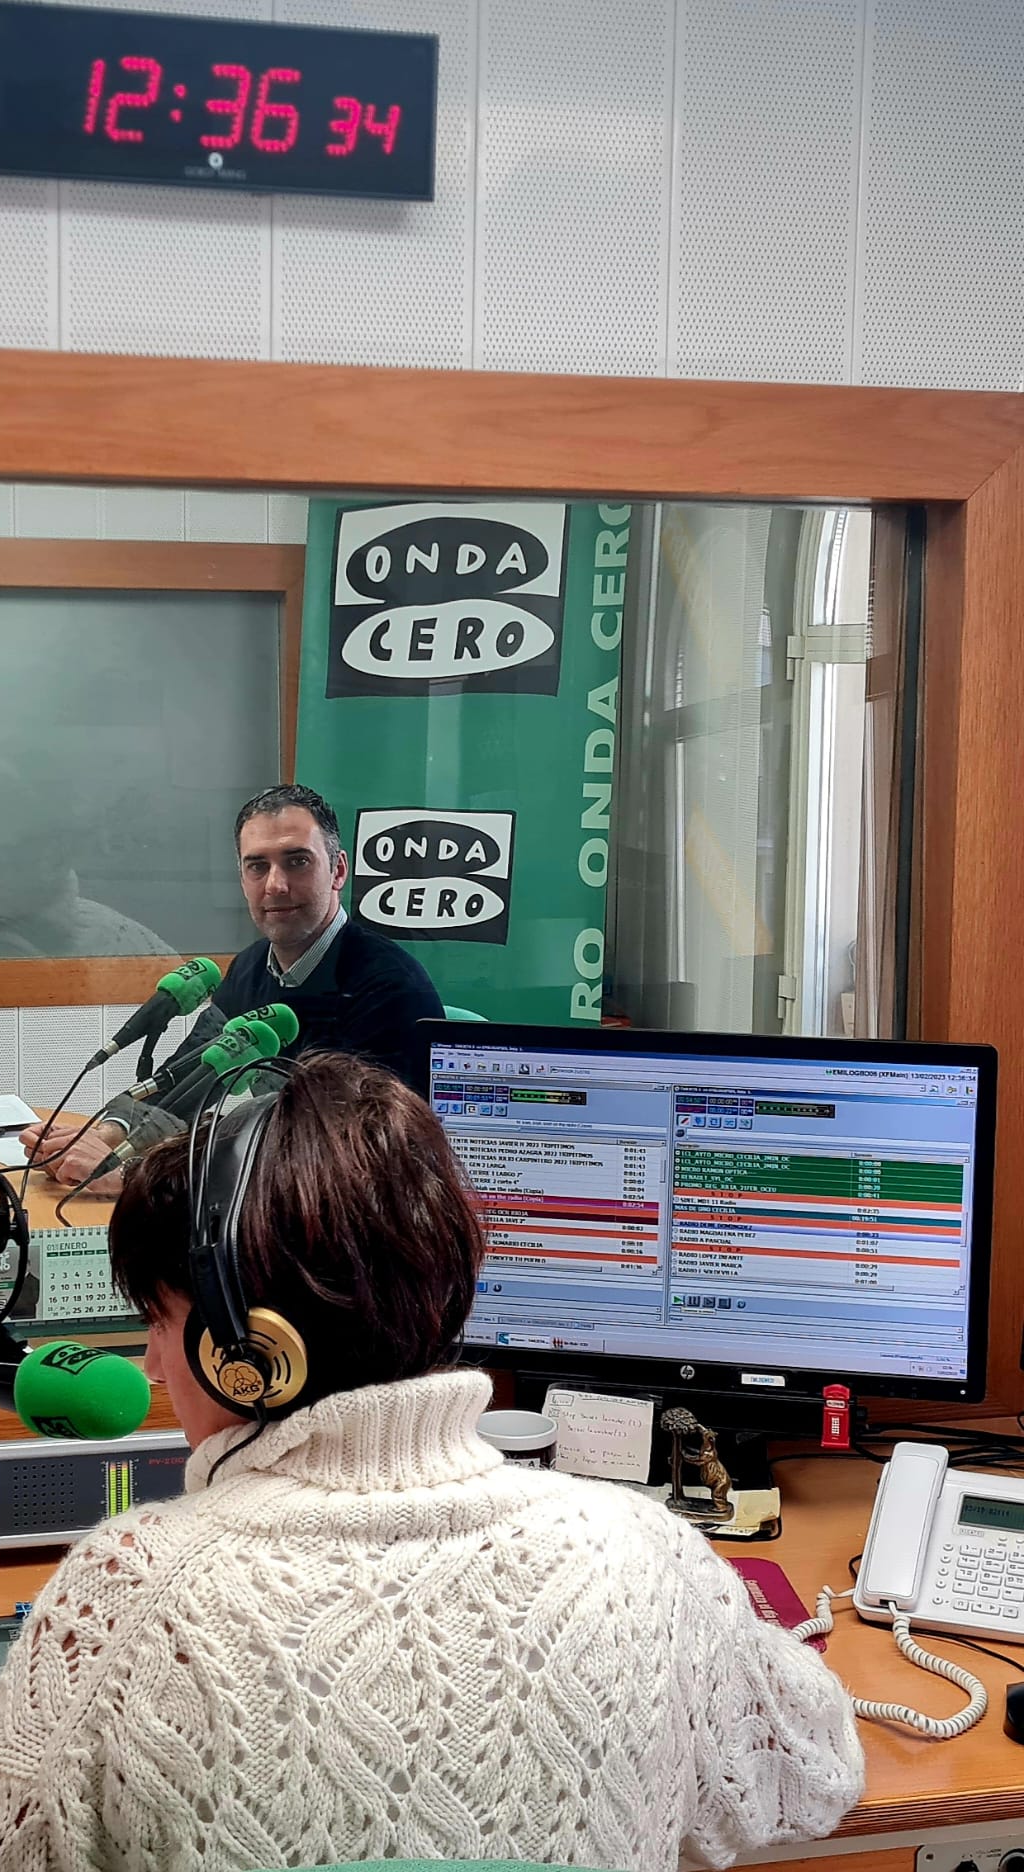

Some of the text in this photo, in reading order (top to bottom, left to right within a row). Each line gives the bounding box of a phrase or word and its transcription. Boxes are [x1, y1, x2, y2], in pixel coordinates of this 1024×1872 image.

[83, 56, 401, 157] 12:36 34
[365, 542, 527, 583] ONDA
[369, 617, 525, 662] CERO
[578, 675, 619, 888] ONDA
[375, 836, 487, 863] ONDA
[378, 886, 484, 918] CERO
[59, 1241, 88, 1250] ENERO
[96, 1293, 107, 1301] 20
[97, 1281, 106, 1289] 13
[84, 1306, 94, 1314] 26
[96, 1305, 106, 1313] 27
[108, 1304, 118, 1312] 28
[233, 1384, 260, 1397] AKG
